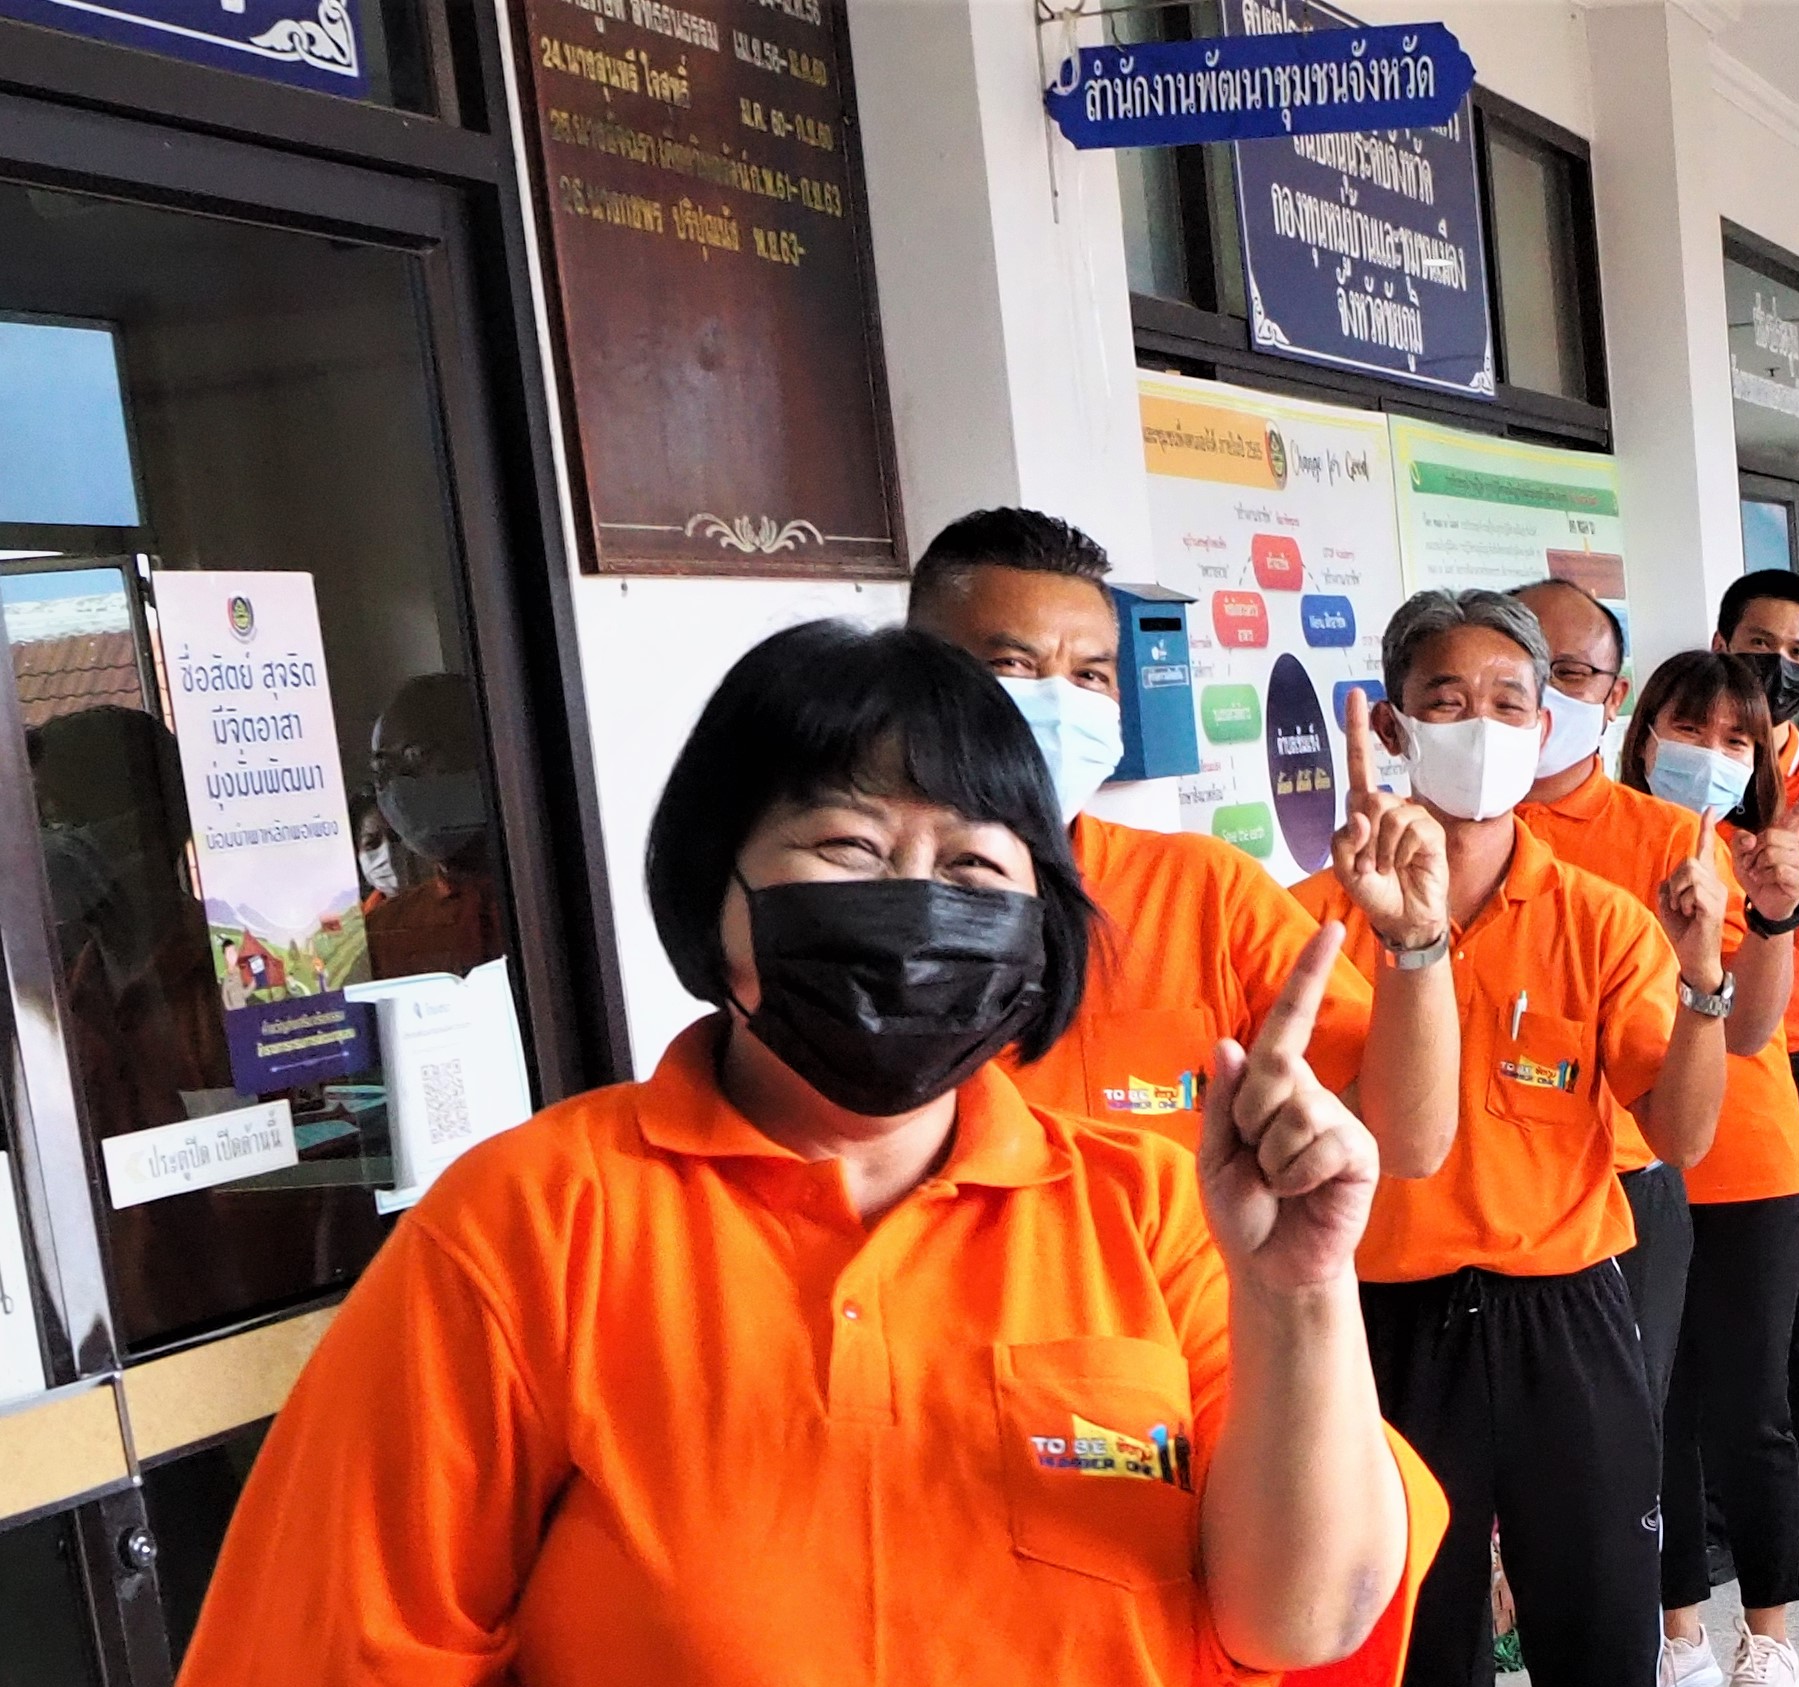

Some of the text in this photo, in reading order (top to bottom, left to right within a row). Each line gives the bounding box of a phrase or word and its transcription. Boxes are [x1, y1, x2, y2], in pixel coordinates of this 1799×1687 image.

[1084, 35, 1435, 132] สำนักงานพัฒนาชุมชนจังหวัด
[1336, 266, 1423, 373] จังหวัดชัยภูมิ
[180, 642, 317, 702] ซื่อสัตย์ สุจริต
[212, 707, 304, 748] มีจิตอาสา
[205, 749, 325, 810] มุ่งมั่นพัฒนา
[1103, 1088, 1125, 1101] TO
[1030, 1434, 1067, 1456] TO
[1073, 1436, 1107, 1456] BE
